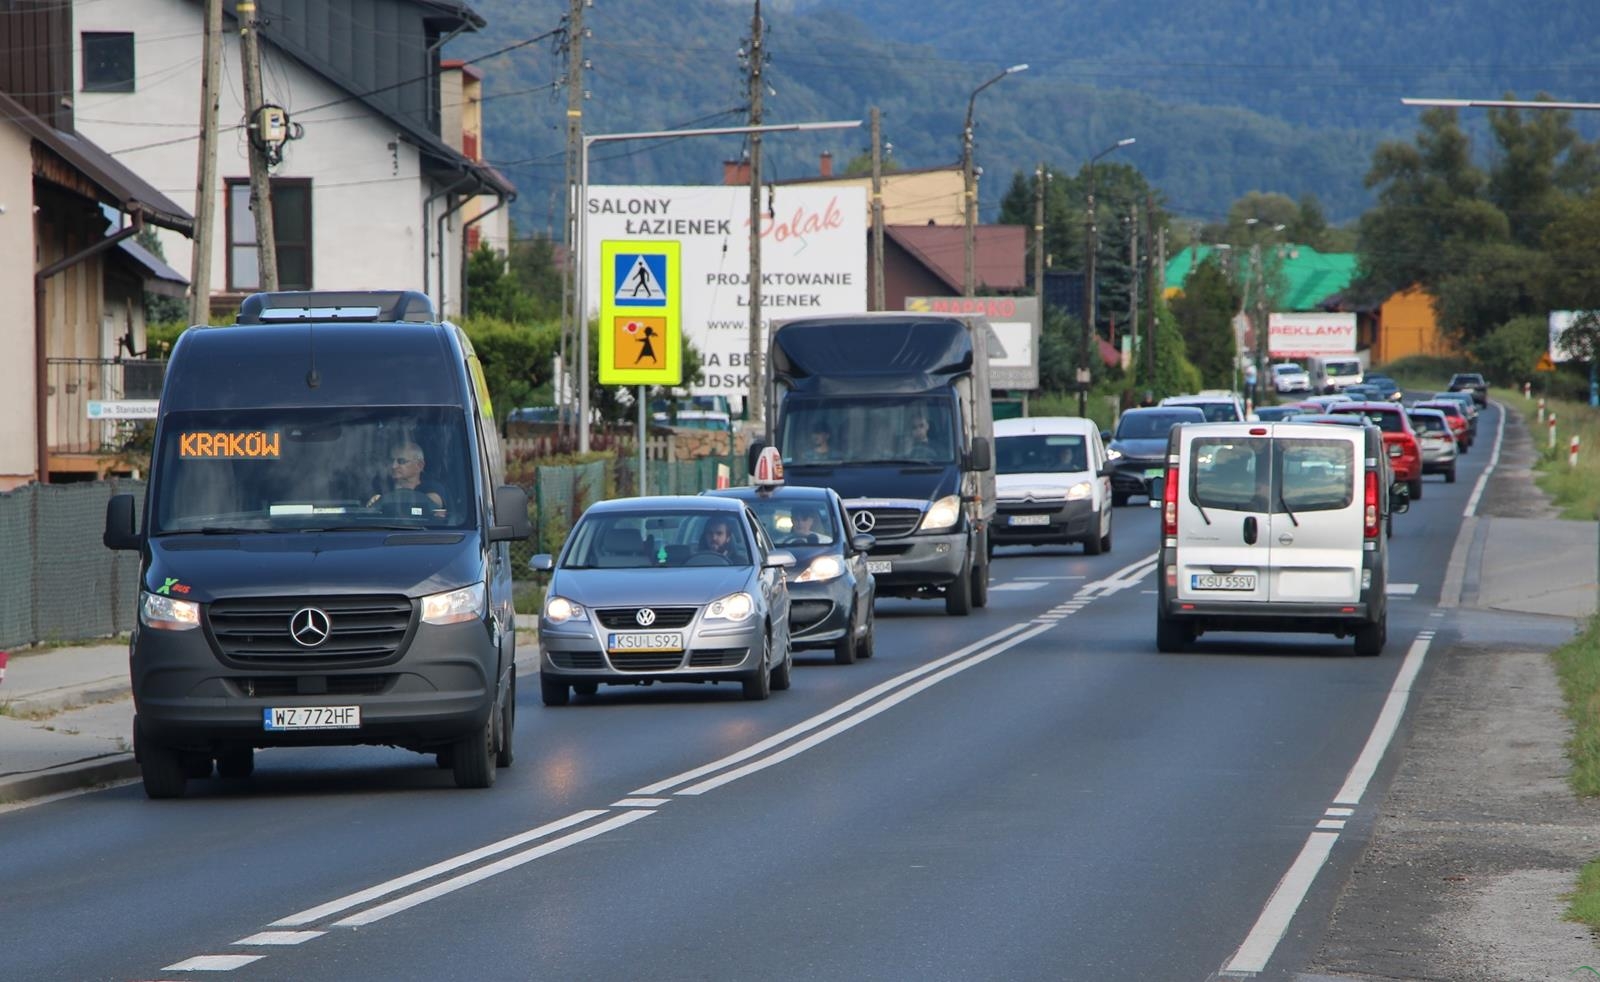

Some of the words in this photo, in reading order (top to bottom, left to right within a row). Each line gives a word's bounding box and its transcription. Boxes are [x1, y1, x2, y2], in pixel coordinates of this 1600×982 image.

[587, 199, 672, 215] SALONY
[625, 219, 732, 235] ŁAZIENEK
[706, 273, 852, 285] PROJKTOWANIE
[1268, 325, 1353, 336] REKLAMY
[180, 432, 279, 457] KRAKÓW
[1199, 576, 1223, 588] KSU
[617, 635, 640, 648] KSU
[276, 709, 297, 725] WZ
[303, 708, 355, 724] 772HF
